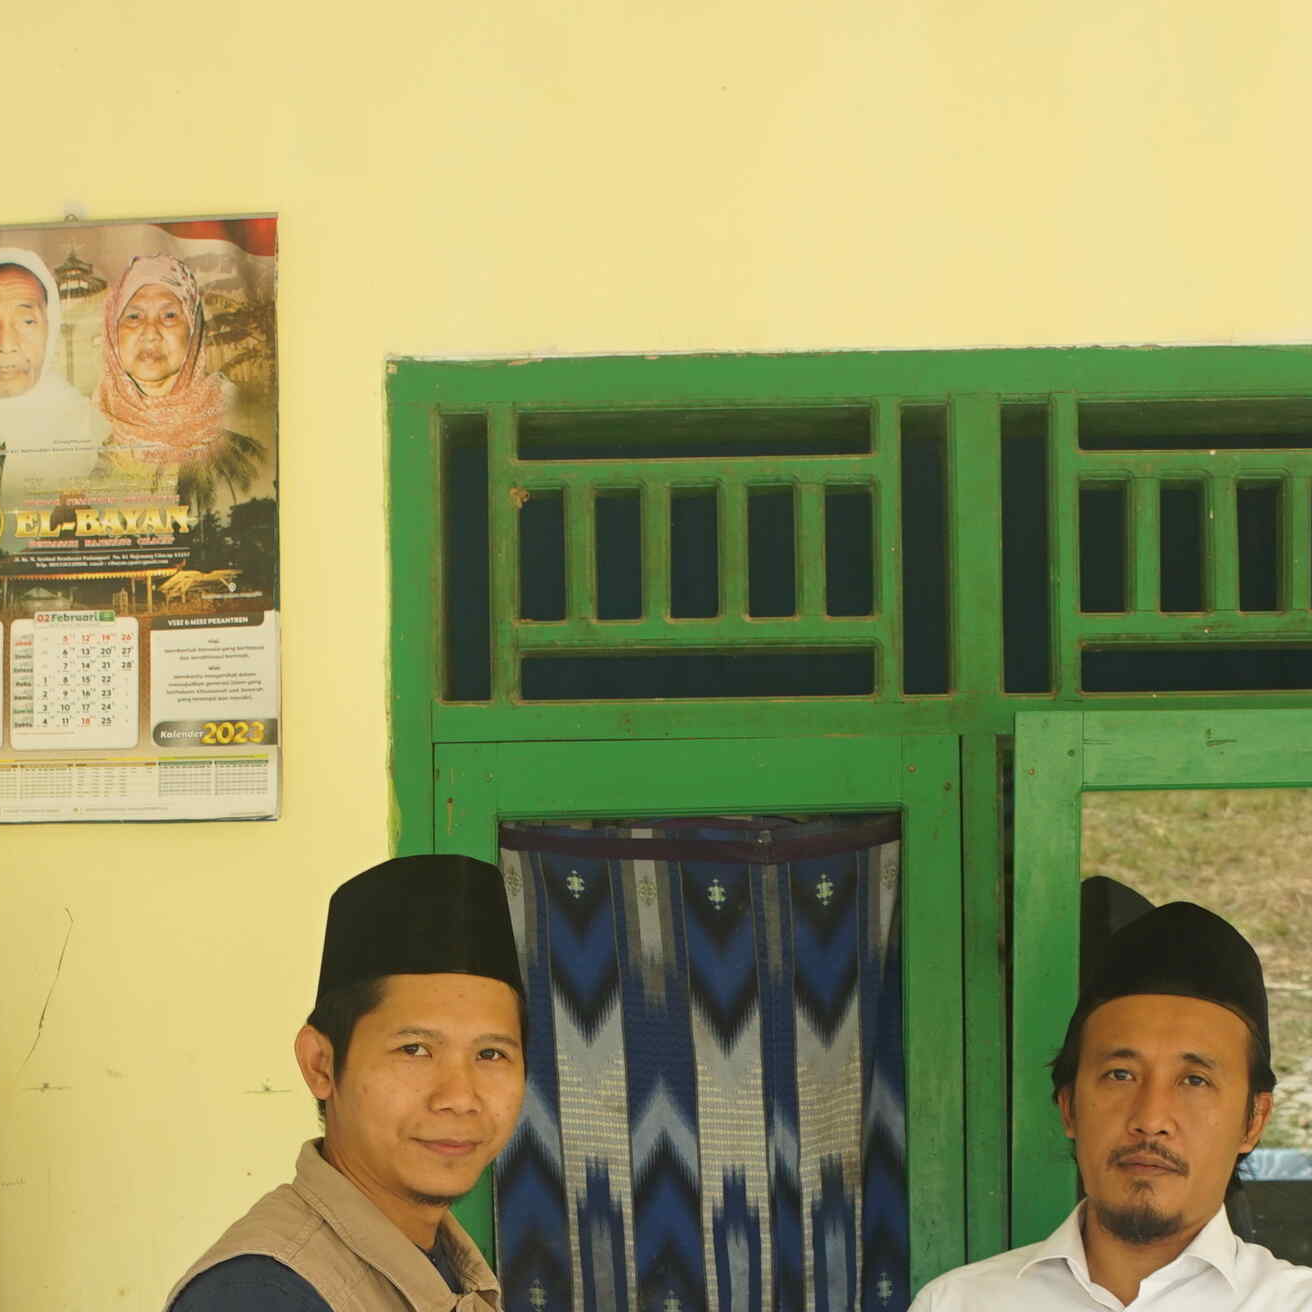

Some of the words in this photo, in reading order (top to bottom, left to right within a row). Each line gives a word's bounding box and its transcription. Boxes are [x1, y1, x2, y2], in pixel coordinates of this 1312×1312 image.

[16, 506, 189, 537] EL-BAYAN
[52, 613, 96, 622] Februari
[208, 616, 248, 625] PESANTREN
[160, 729, 204, 739] Kalender
[202, 721, 265, 744] 2023
